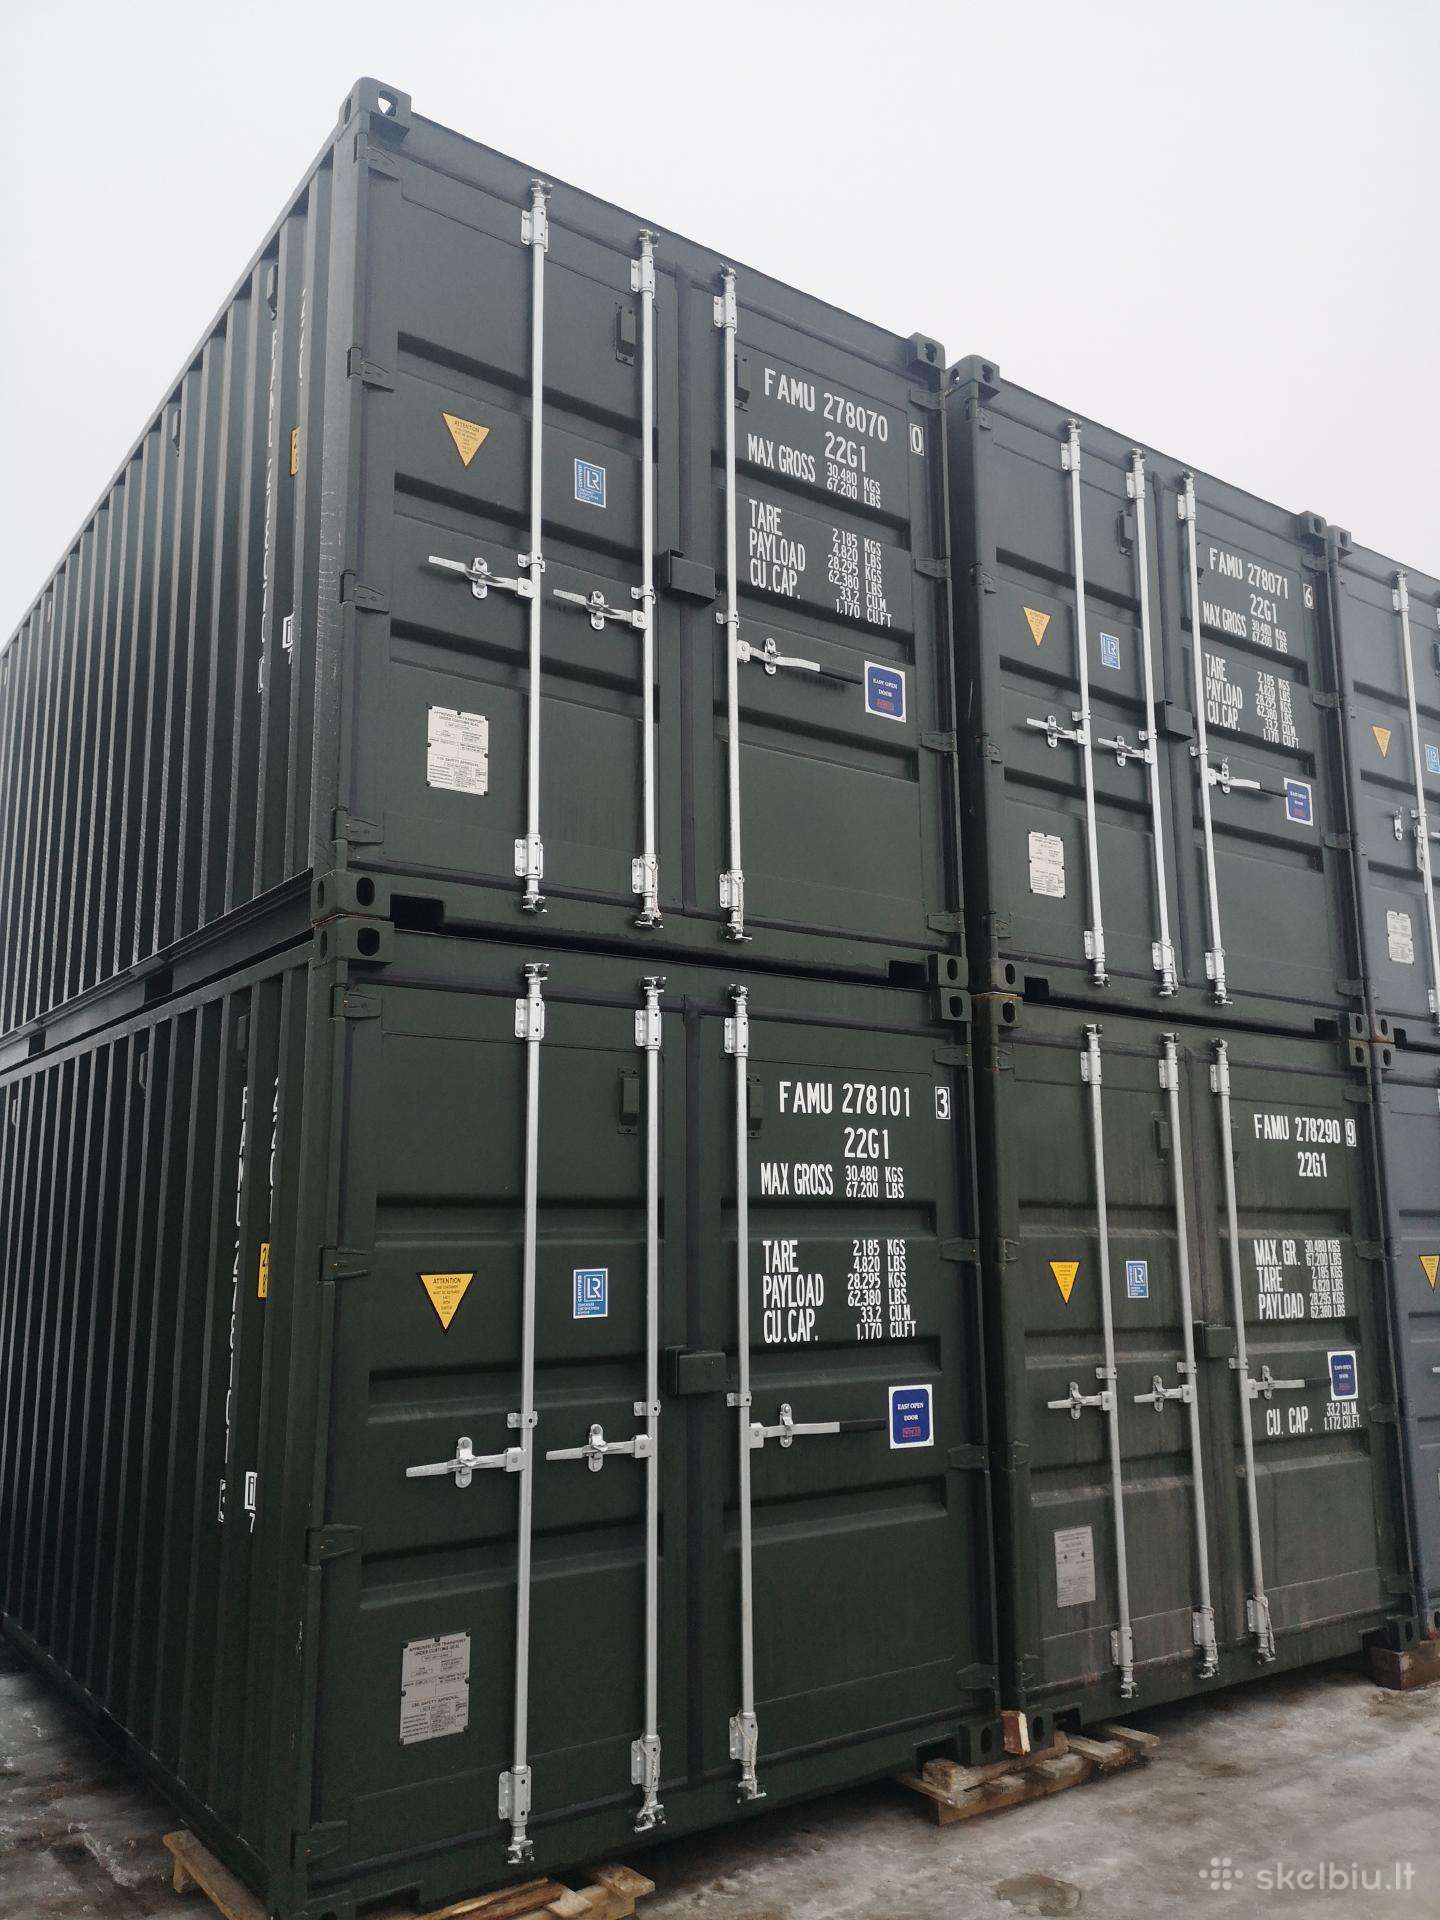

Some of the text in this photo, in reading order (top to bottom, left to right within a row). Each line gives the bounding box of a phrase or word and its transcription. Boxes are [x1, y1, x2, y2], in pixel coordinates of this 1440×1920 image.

[764, 368, 816, 412] FAMU
[823, 393, 888, 442] 278070
[748, 433, 816, 483] MAX GROSS
[824, 431, 866, 473] 22G1
[863, 476, 881, 495] KGS
[864, 490, 881, 508] LBS
[749, 499, 783, 536] TARE
[749, 528, 806, 572] PAYLOAD
[864, 537, 881, 556] KGS
[864, 552, 882, 570] LBS
[864, 565, 882, 584] KGS
[1209, 547, 1243, 580] FAMU
[1247, 563, 1288, 600] 278071
[840, 586, 860, 605] 33.2
[865, 580, 883, 598] LBS
[1203, 601, 1247, 638] MAX GROSS
[1249, 593, 1277, 624] 22G1
[1205, 652, 1227, 682] TARE
[1206, 676, 1243, 710] PAYLOAD
[779, 1081, 949, 1118] FAMU 278101 3
[1253, 1113, 1356, 1146] FAMU 278290 9
[844, 1127, 889, 1160] 22G1
[885, 1166, 904, 1183] KGS
[1297, 1151, 1328, 1178] 22G1
[760, 1162, 834, 1196] MAX GROSS
[886, 1183, 905, 1199] LBS
[762, 1240, 799, 1274] TARE
[886, 1239, 906, 1256] KGS
[1253, 1239, 1301, 1266] MAX. GR.
[1327, 1239, 1341, 1253] KGS
[1329, 1252, 1342, 1266] LBS
[887, 1255, 907, 1272] LBS
[1330, 1265, 1343, 1279] KGS
[762, 1273, 825, 1309] PAYLOAD
[887, 1272, 907, 1289] KGS
[1256, 1266, 1284, 1293] TARE
[1331, 1278, 1344, 1292] LBS
[888, 1288, 908, 1305] LBS
[1258, 1292, 1305, 1320] PAYLOAD
[1332, 1291, 1345, 1305] KGS
[860, 1306, 882, 1323] 33.2
[1333, 1304, 1346, 1318] LBS
[763, 1308, 819, 1344] CU.CAP.
[889, 1321, 917, 1338] CU.FT
[1266, 1406, 1313, 1436] CU. CAP.
